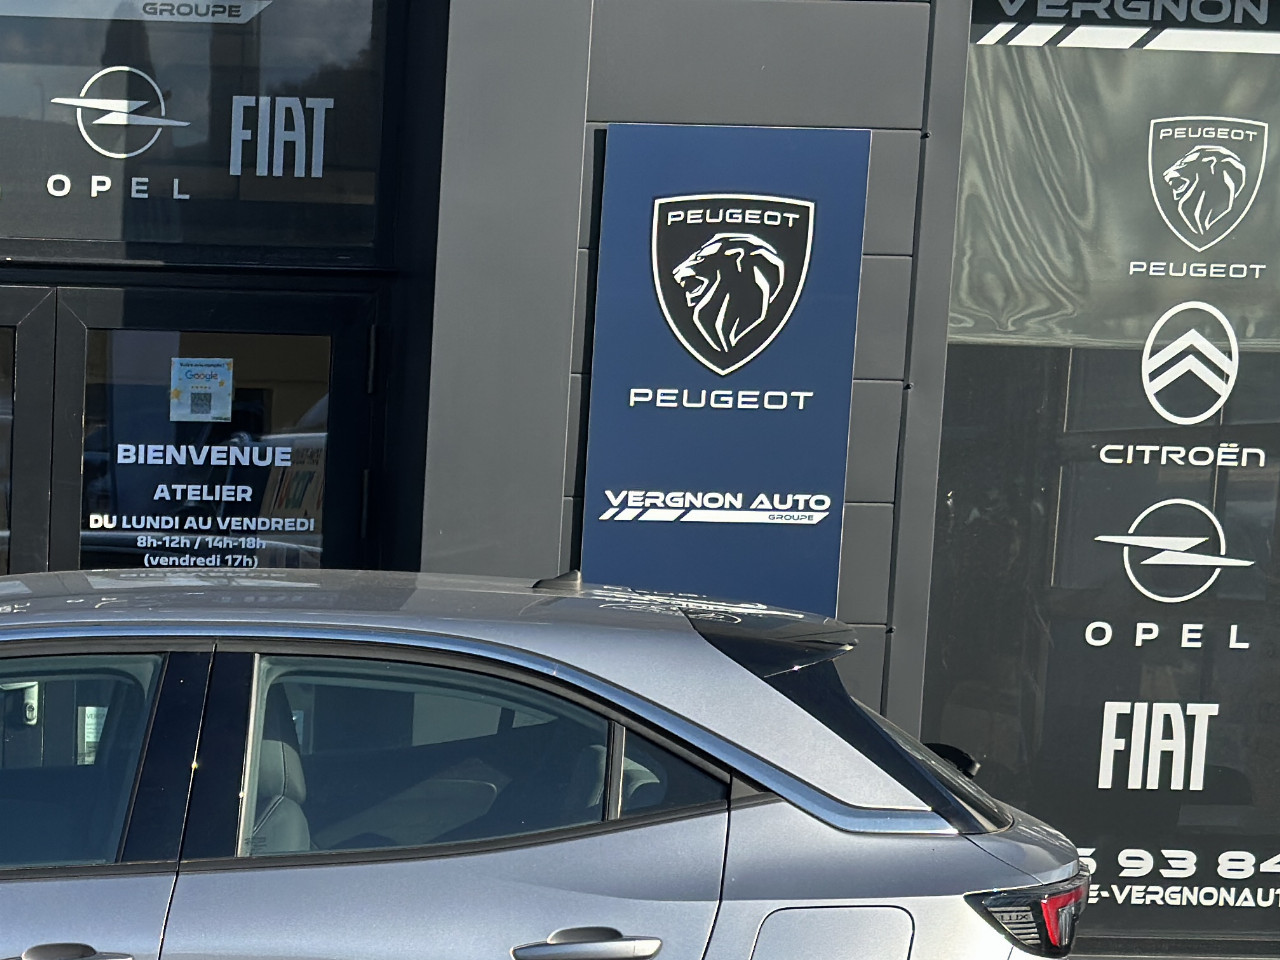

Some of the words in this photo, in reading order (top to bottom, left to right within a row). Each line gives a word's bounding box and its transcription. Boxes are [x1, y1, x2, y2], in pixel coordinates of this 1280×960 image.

[143, 2, 242, 18] GROUPE
[229, 95, 334, 178] FIAT
[1159, 127, 1258, 142] PEUGEOT
[47, 173, 191, 200] OPEL
[667, 209, 800, 227] PEUGEOT
[1128, 261, 1266, 279] PEUGEOT
[185, 370, 218, 381] Google
[629, 388, 813, 410] PEUGEOT
[117, 444, 292, 467] BIENVENUE
[1100, 443, 1265, 467] CITROËN
[154, 484, 252, 502] ATELIER
[604, 490, 744, 510] VERGNON
[749, 493, 831, 511] AUTO
[89, 514, 117, 529] DU
[122, 516, 179, 530] LUNDI
[184, 517, 211, 530] AU
[216, 517, 314, 531] VENDREDI
[768, 513, 814, 521] GROUPE
[136, 536, 190, 549] 8h-12h
[194, 536, 201, 550] /
[205, 537, 266, 549] 14h-18h
[144, 554, 220, 568] (vendredi
[224, 555, 258, 569] 17h)
[1085, 621, 1250, 649] OPEL
[1098, 702, 1219, 791] FIAT
[1117, 848, 1197, 879] 93
[1217, 850, 1280, 880] 84
